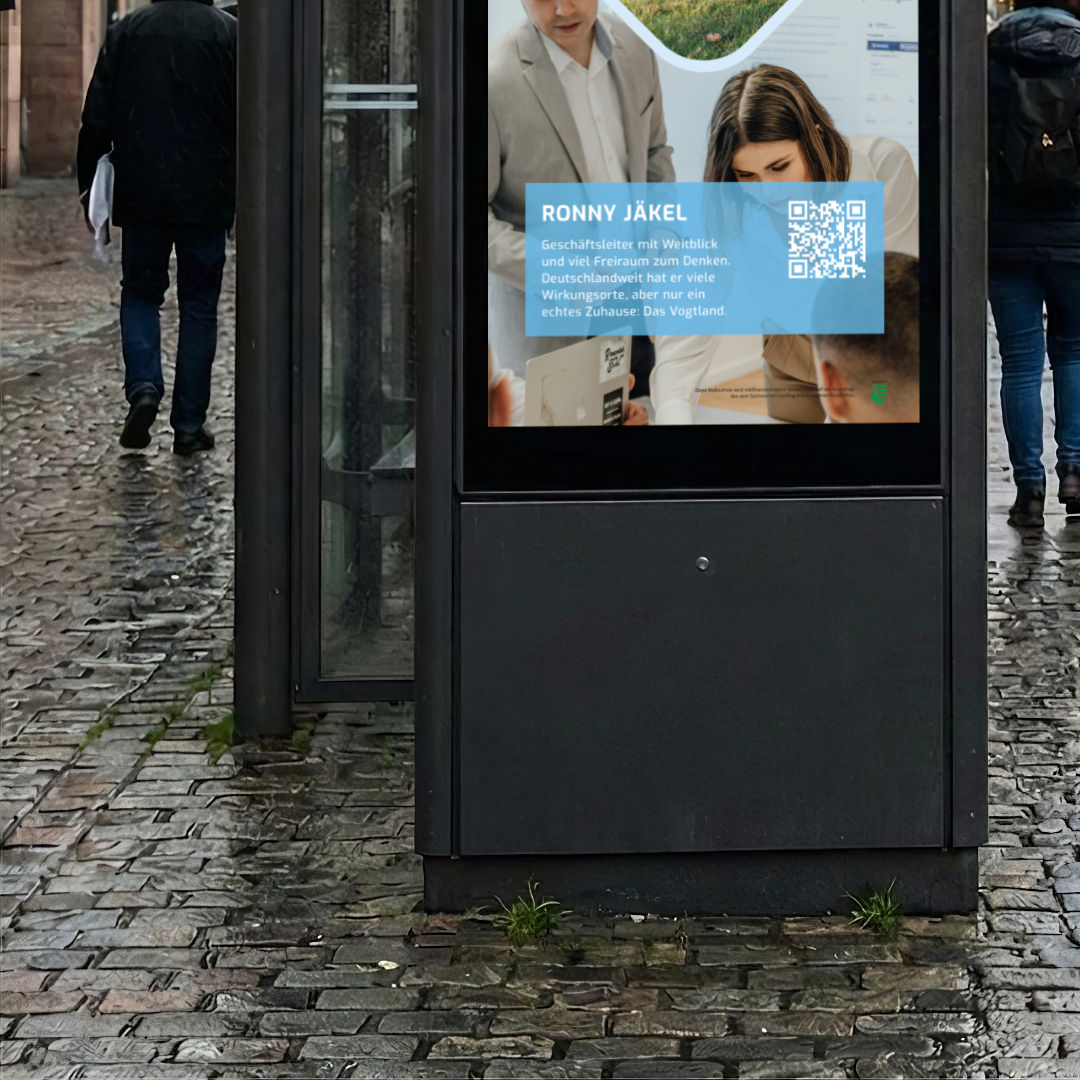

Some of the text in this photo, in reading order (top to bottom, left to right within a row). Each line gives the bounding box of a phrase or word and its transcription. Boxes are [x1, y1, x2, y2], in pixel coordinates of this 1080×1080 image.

[542, 200, 688, 222] RONNY JÄKEL
[541, 238, 718, 250] Geschäftsleiter mit Weitblick
[541, 255, 731, 267] und viel Freiraum zum Denken.
[541, 271, 716, 284] Deutschlandweit hat er viele
[541, 288, 706, 303] Wirkungsorte, aber nur ein
[541, 305, 728, 320] echtes Zuhause: Das Vogtland.
